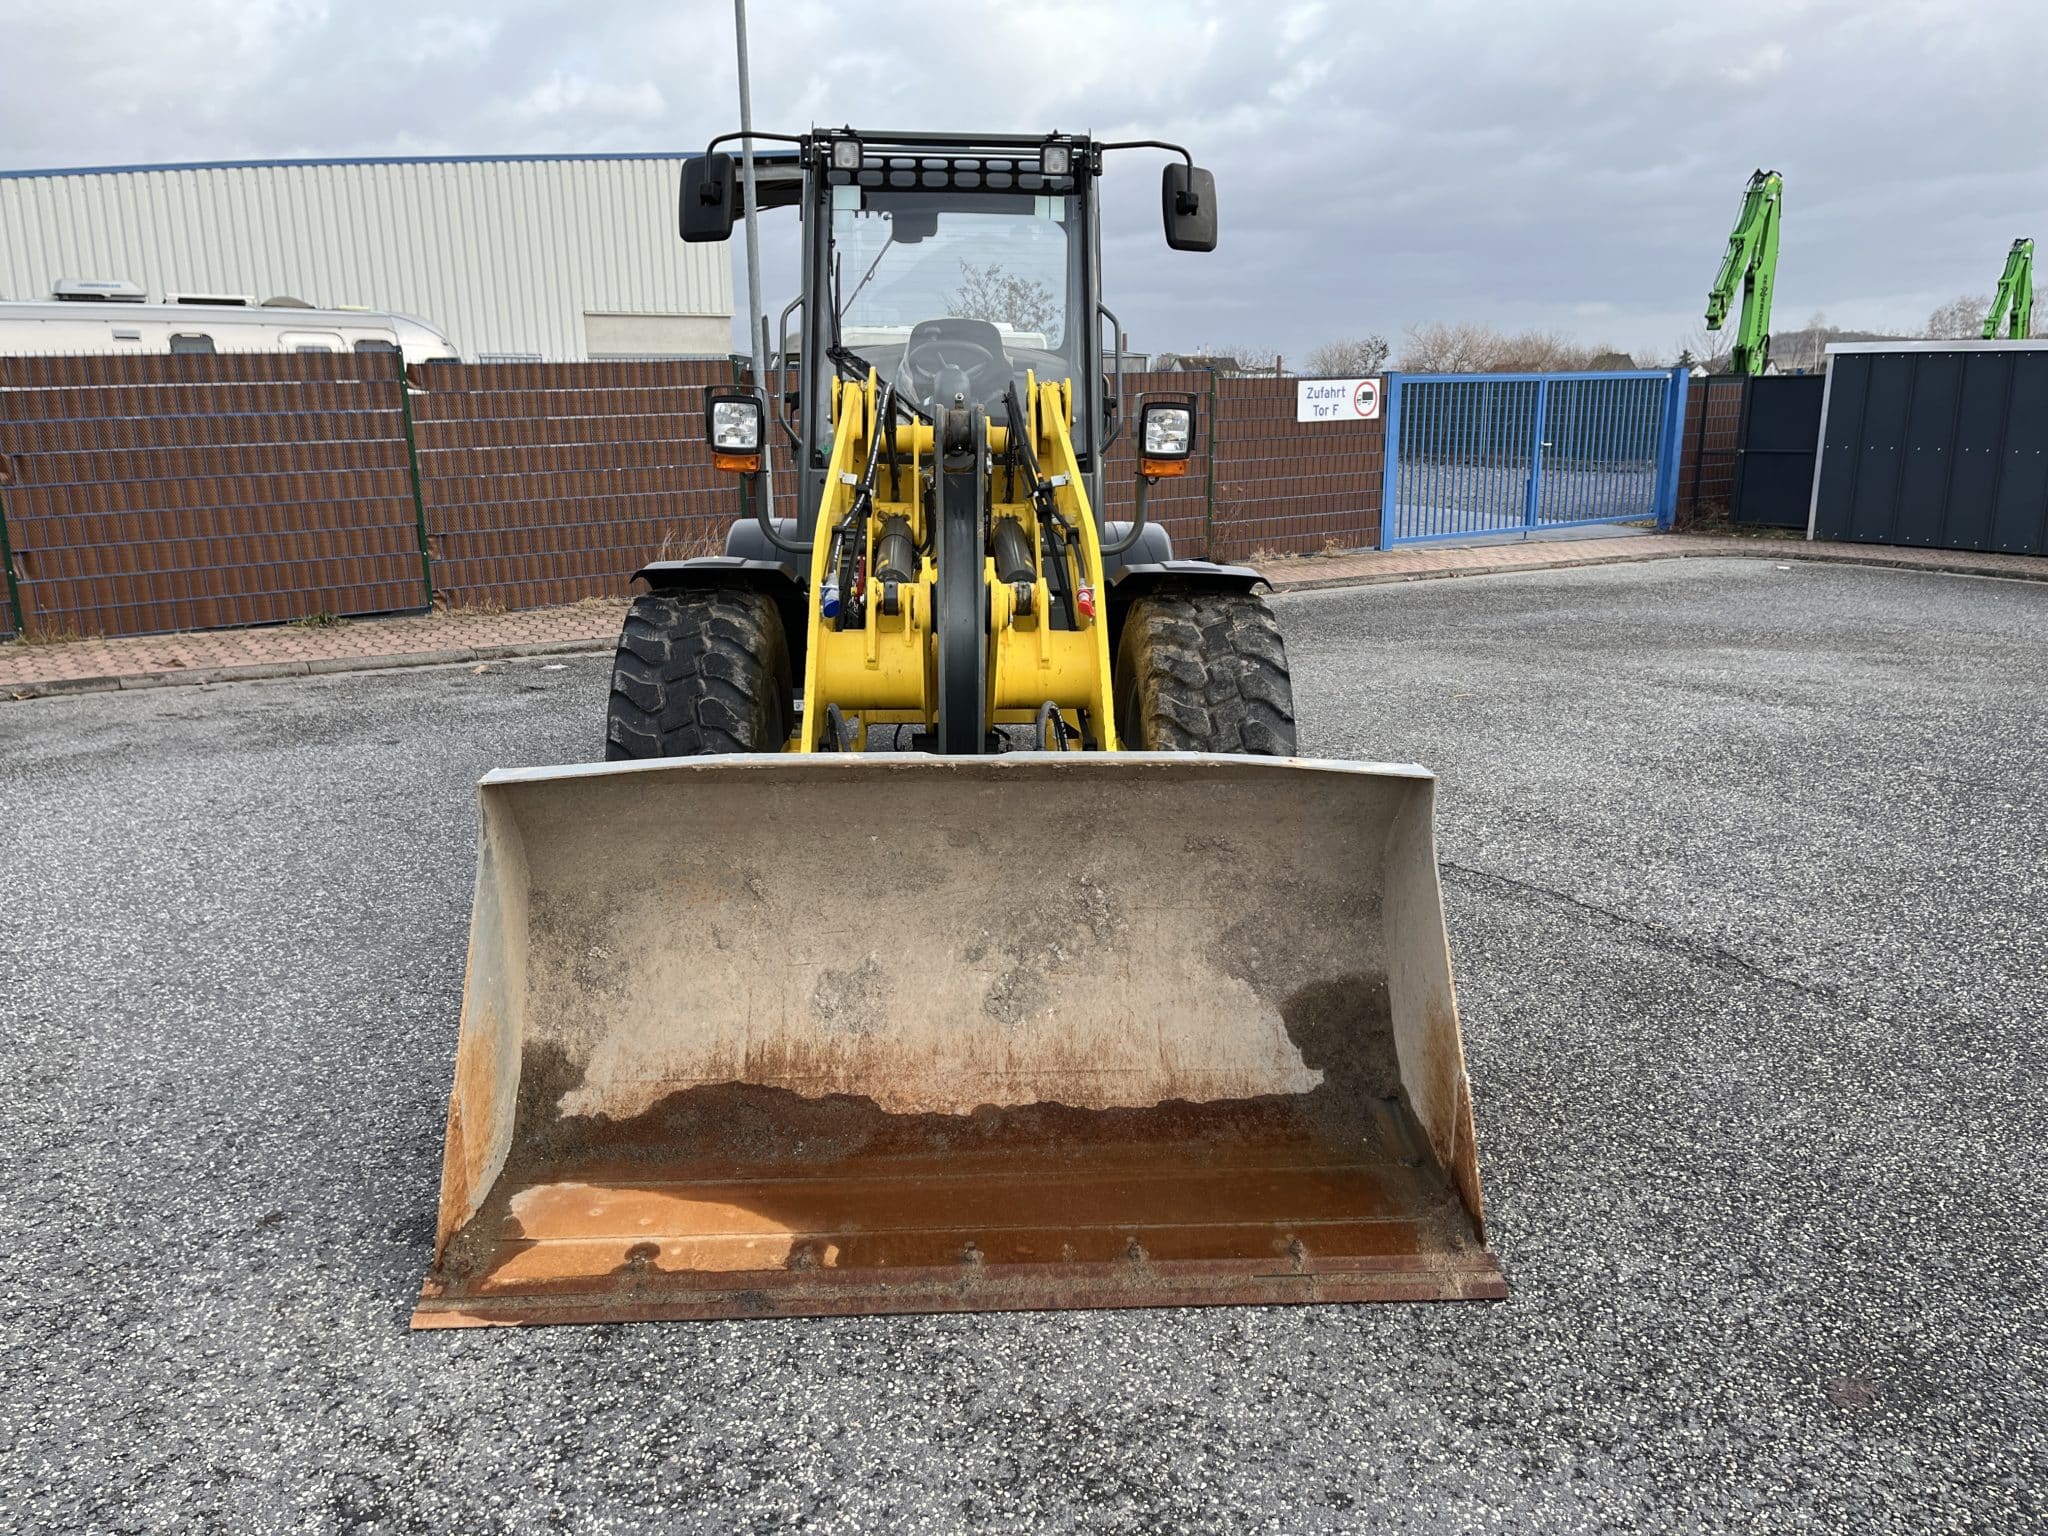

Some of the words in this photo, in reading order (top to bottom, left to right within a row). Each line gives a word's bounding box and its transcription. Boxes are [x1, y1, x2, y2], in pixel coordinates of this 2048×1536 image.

[1306, 386, 1346, 399] Zufahrt
[1313, 404, 1329, 416] Tor
[1332, 404, 1339, 416] F
